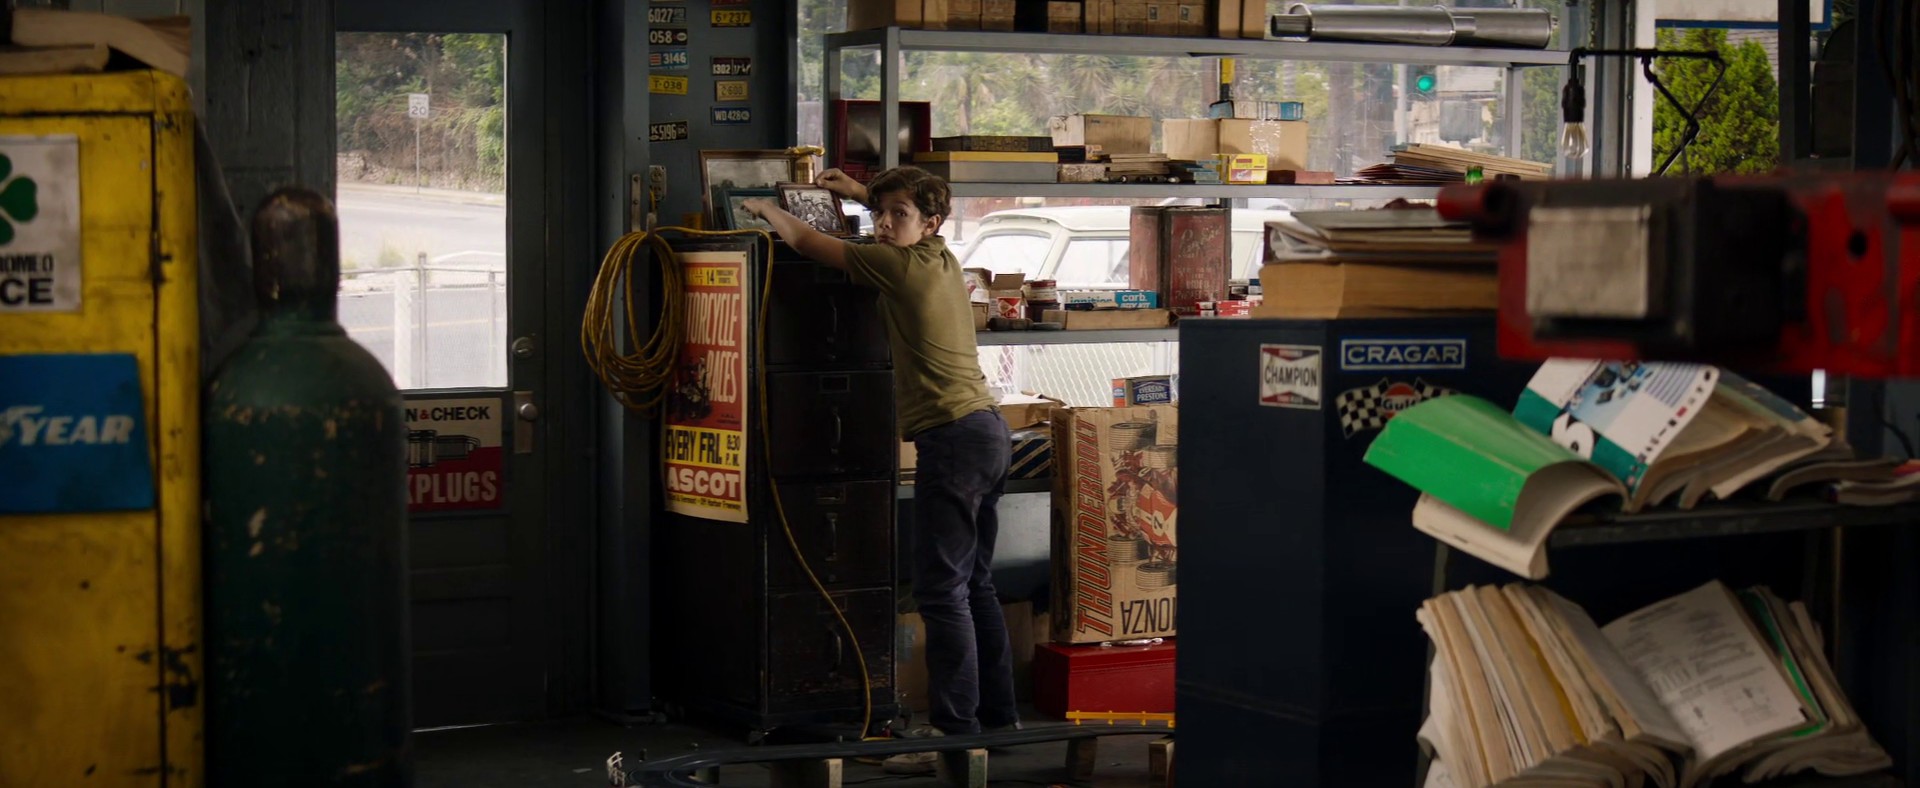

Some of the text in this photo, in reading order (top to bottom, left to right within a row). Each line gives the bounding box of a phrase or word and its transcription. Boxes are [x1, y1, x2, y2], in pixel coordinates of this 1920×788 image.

[648, 8, 673, 22] 6027
[663, 52, 686, 64] 3146
[412, 106, 426, 115] 20
[1347, 346, 1459, 363] CRAGAR
[707, 349, 739, 404] RACES
[1264, 366, 1317, 387] CHAMPION
[1137, 392, 1168, 401] PRESTONE
[431, 406, 490, 421] CHECK
[666, 429, 696, 461] EVERY
[700, 432, 722, 464] FRI.
[667, 467, 739, 498] ASCOT
[1076, 416, 1113, 636] THUNDERBOLT
